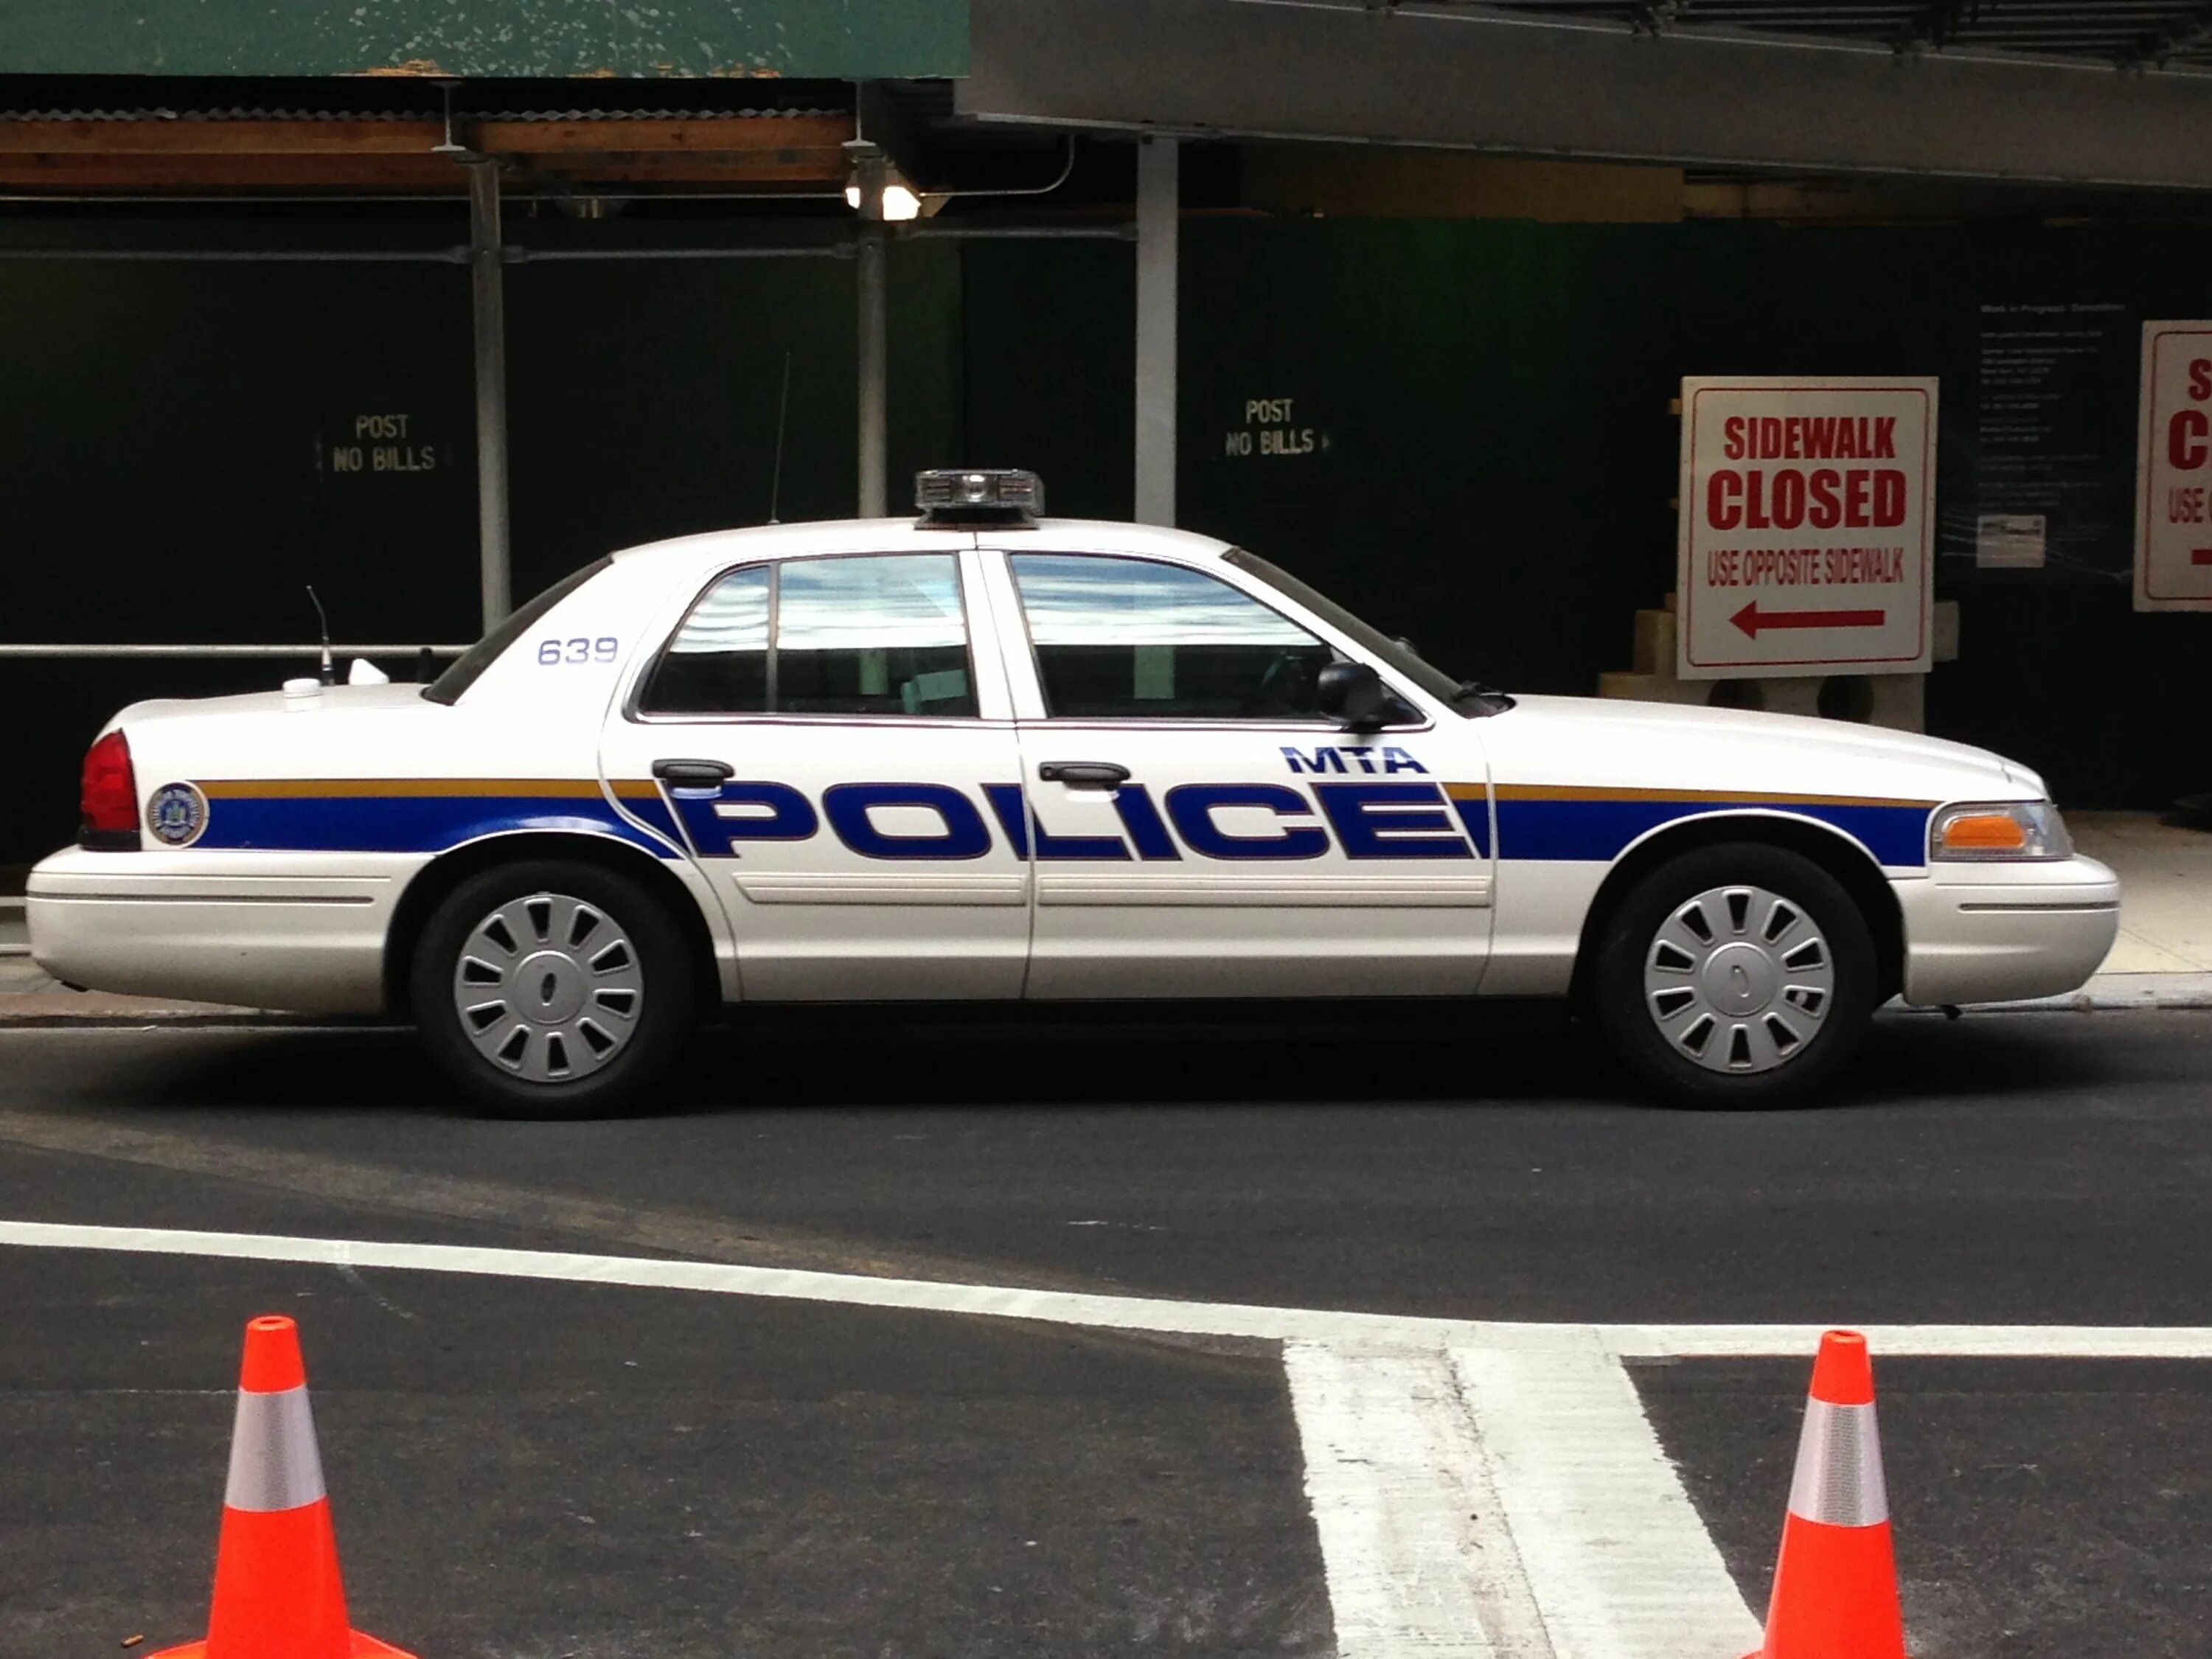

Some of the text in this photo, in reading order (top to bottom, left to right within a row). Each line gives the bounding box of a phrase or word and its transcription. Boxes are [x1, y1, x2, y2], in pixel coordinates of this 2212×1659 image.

[1245, 398, 1294, 424] POST
[355, 414, 409, 439] POST
[1723, 416, 1896, 461] SIDEWALK
[1225, 428, 1315, 456] NO BILLS
[333, 445, 436, 472] NO BILLS
[1706, 468, 1907, 530] CLOSED
[2168, 487, 2205, 524] USE
[1707, 546, 1904, 587] USE OPPOSITE SIDEWALK
[538, 636, 619, 666] 639
[1279, 746, 1430, 774] MTA
[662, 779, 1476, 861] POLICE
